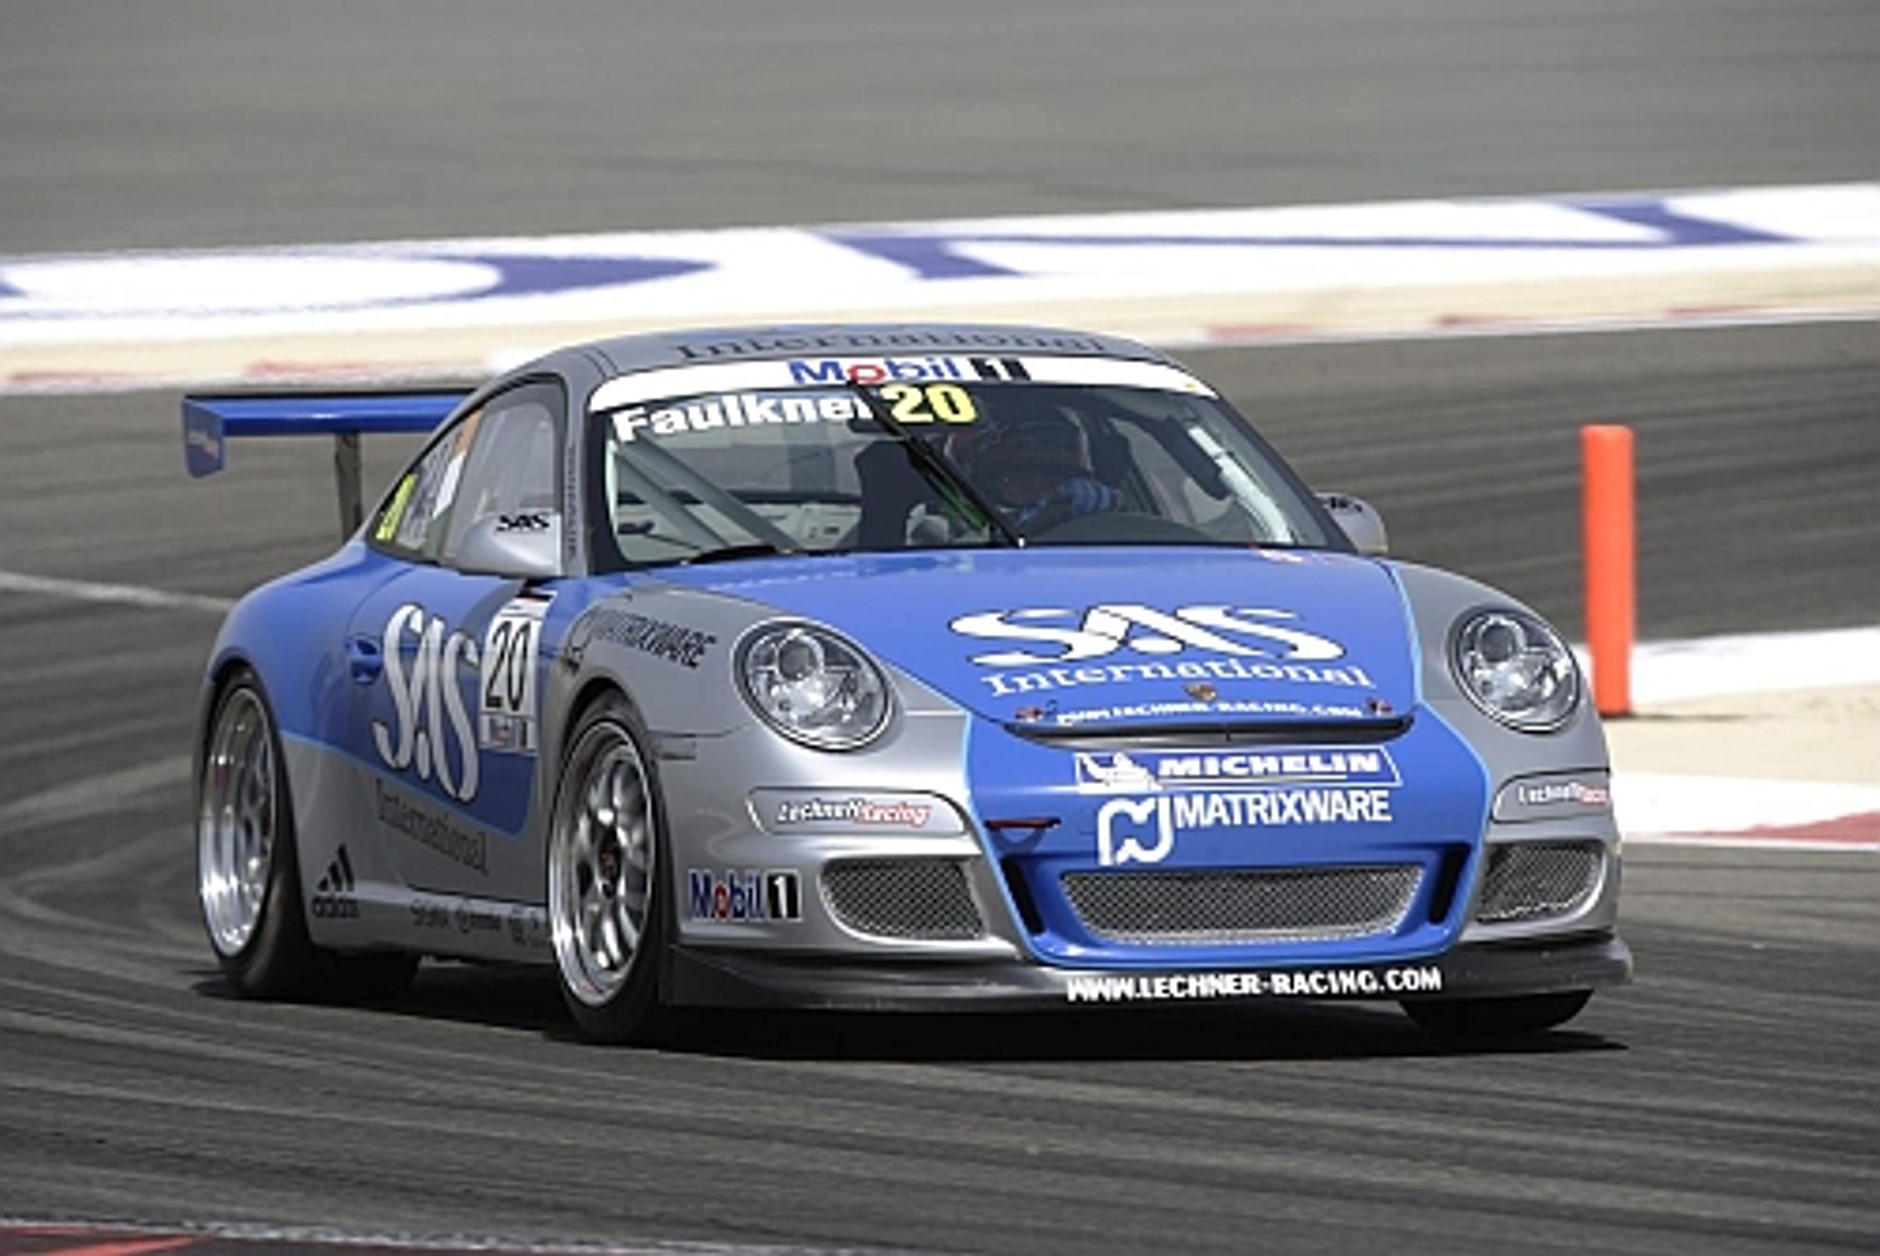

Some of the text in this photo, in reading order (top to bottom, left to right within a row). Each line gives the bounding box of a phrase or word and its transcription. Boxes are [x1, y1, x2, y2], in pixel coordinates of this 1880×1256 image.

[788, 356, 963, 384] Mobil
[879, 384, 977, 424] 20
[496, 513, 550, 531] SAS
[947, 603, 1347, 665] SAS
[484, 619, 532, 712] 20
[980, 656, 1378, 697] International
[373, 603, 480, 803] SAS
[1158, 751, 1381, 779] MICHELIN
[1175, 789, 1393, 829] MATRIXWARE
[688, 868, 765, 921] Mobil
